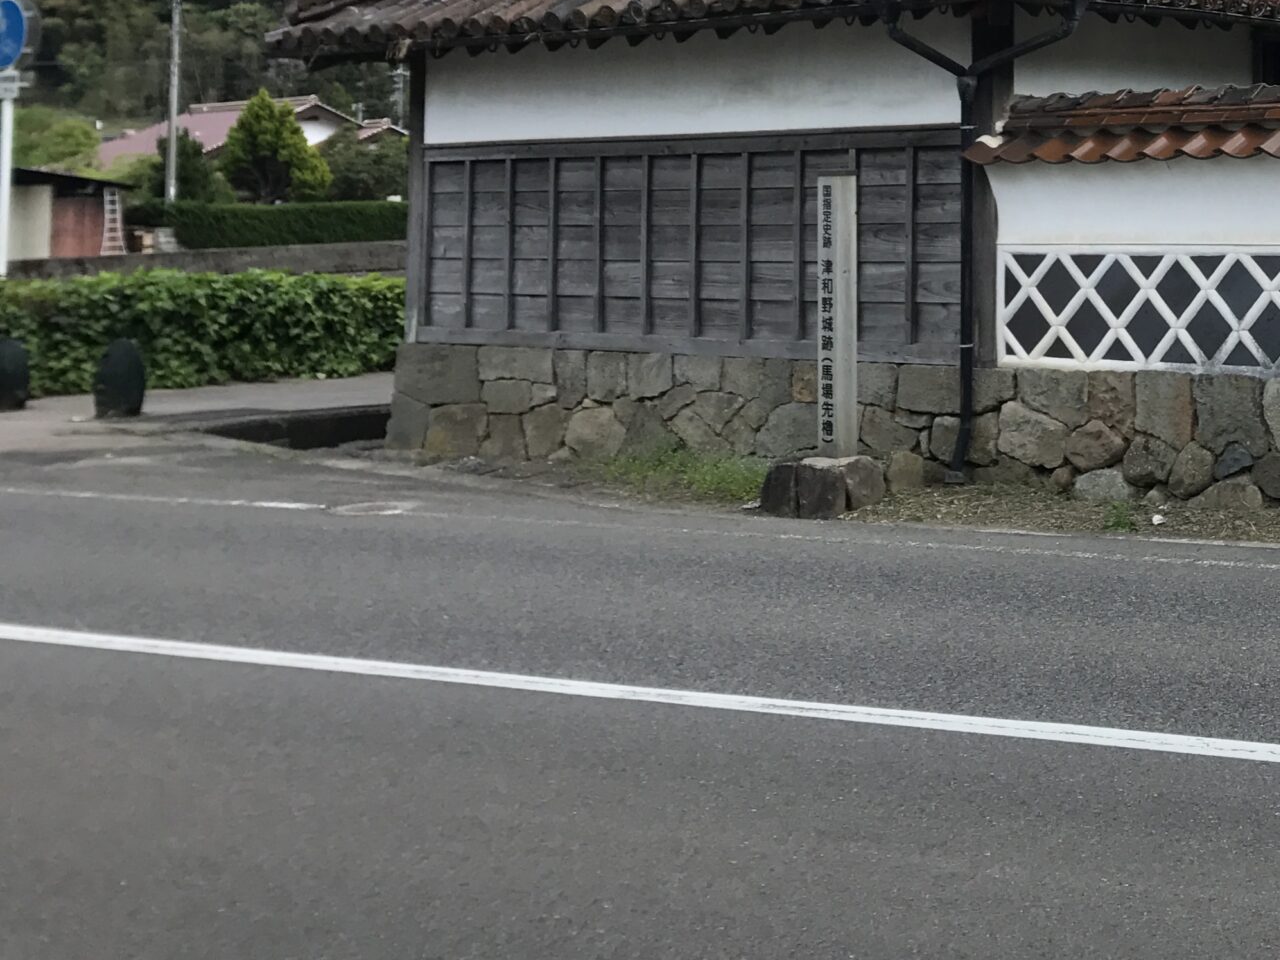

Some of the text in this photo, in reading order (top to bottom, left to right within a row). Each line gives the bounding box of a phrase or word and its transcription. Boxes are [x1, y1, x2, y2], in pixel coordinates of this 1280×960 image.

[822, 184, 833, 249] 国指定史跡
